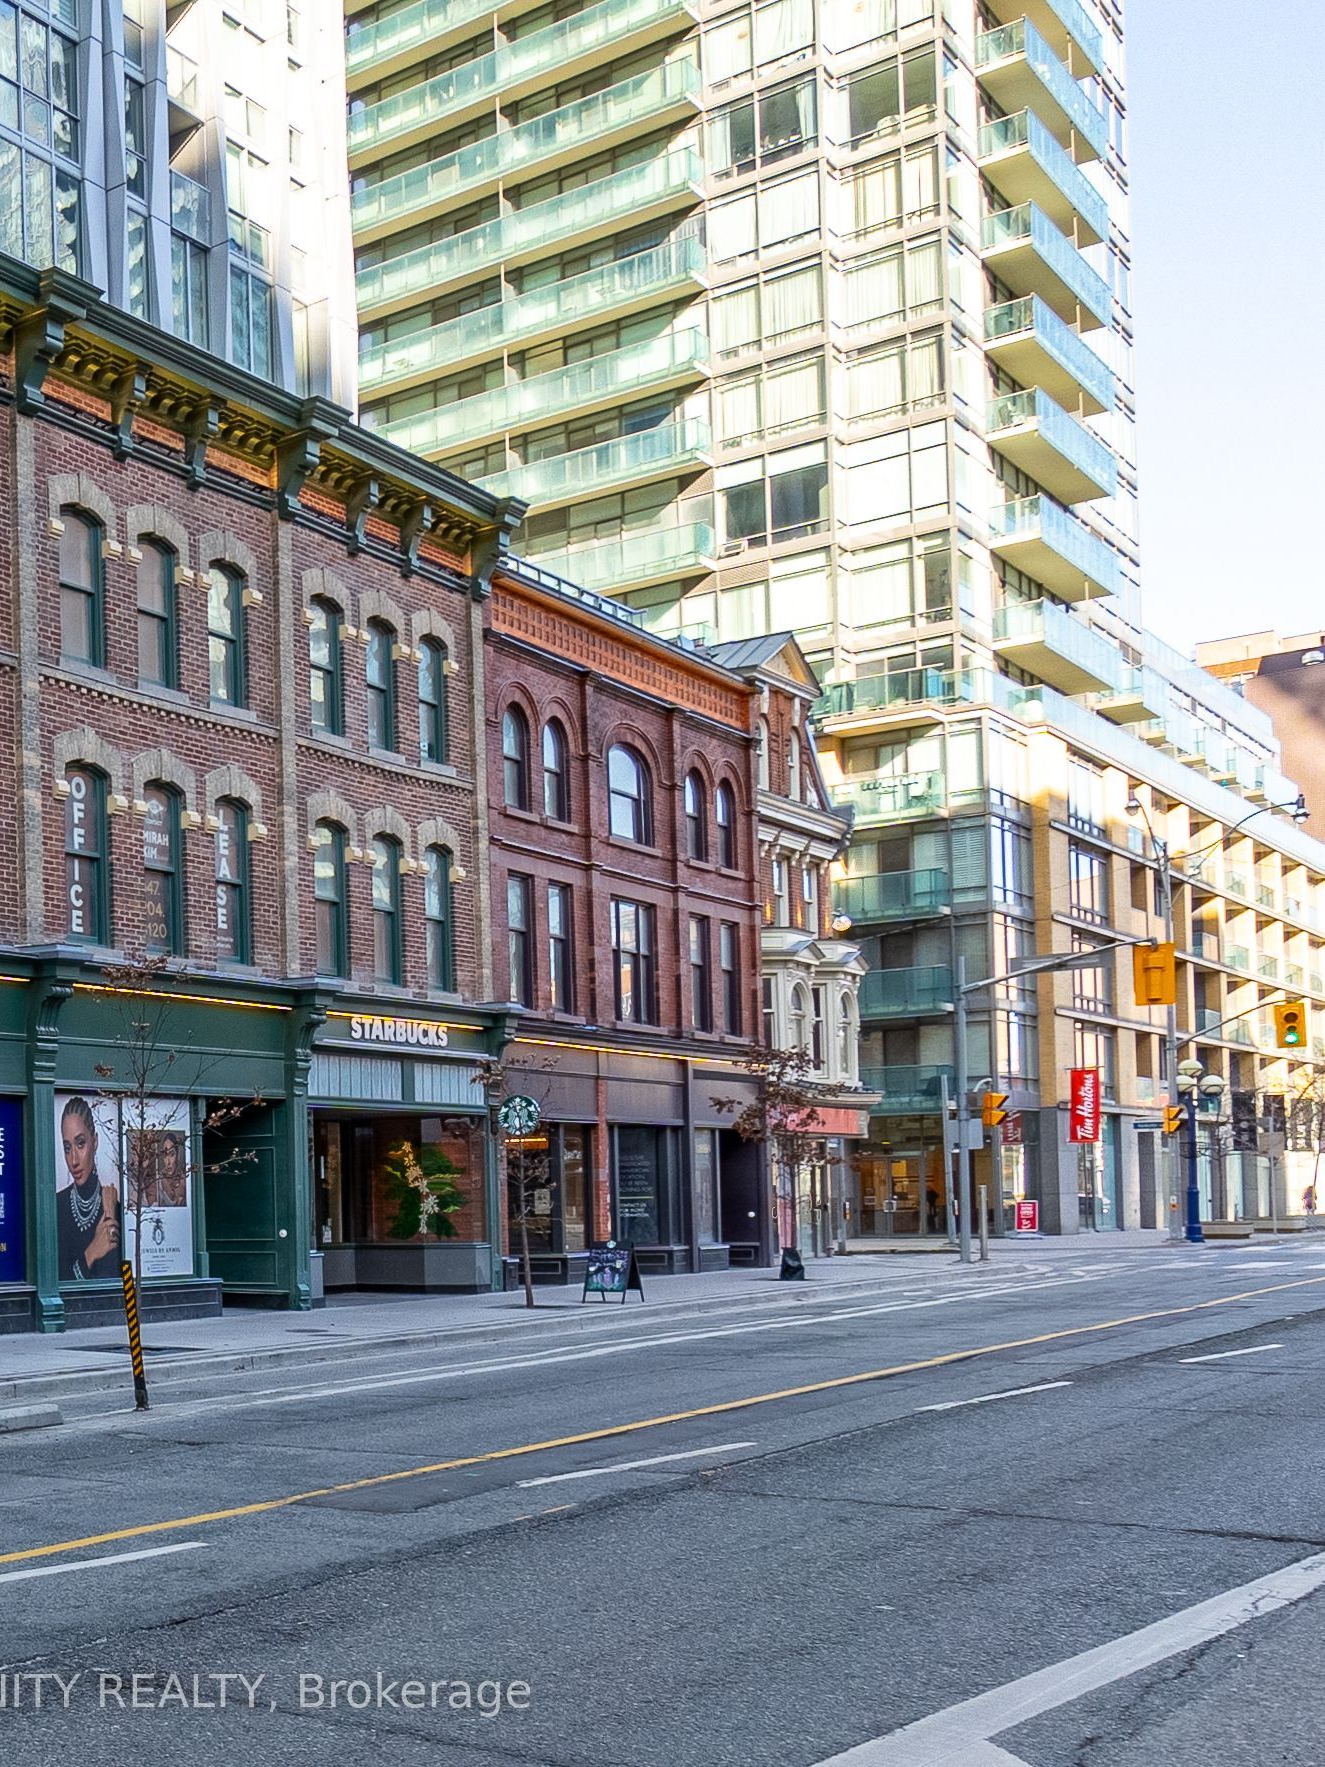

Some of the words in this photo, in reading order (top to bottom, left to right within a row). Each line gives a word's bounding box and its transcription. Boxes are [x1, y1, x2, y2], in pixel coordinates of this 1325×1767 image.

[69, 776, 87, 933] OFFICE
[216, 809, 232, 930] LEASE
[145, 880, 161, 896] 47.
[146, 901, 165, 918] 04.
[146, 922, 167, 939] 120
[350, 1017, 448, 1047] STARBUCKS
[1075, 1073, 1095, 1118] Hortons
[1075, 1118, 1095, 1140] Tim
